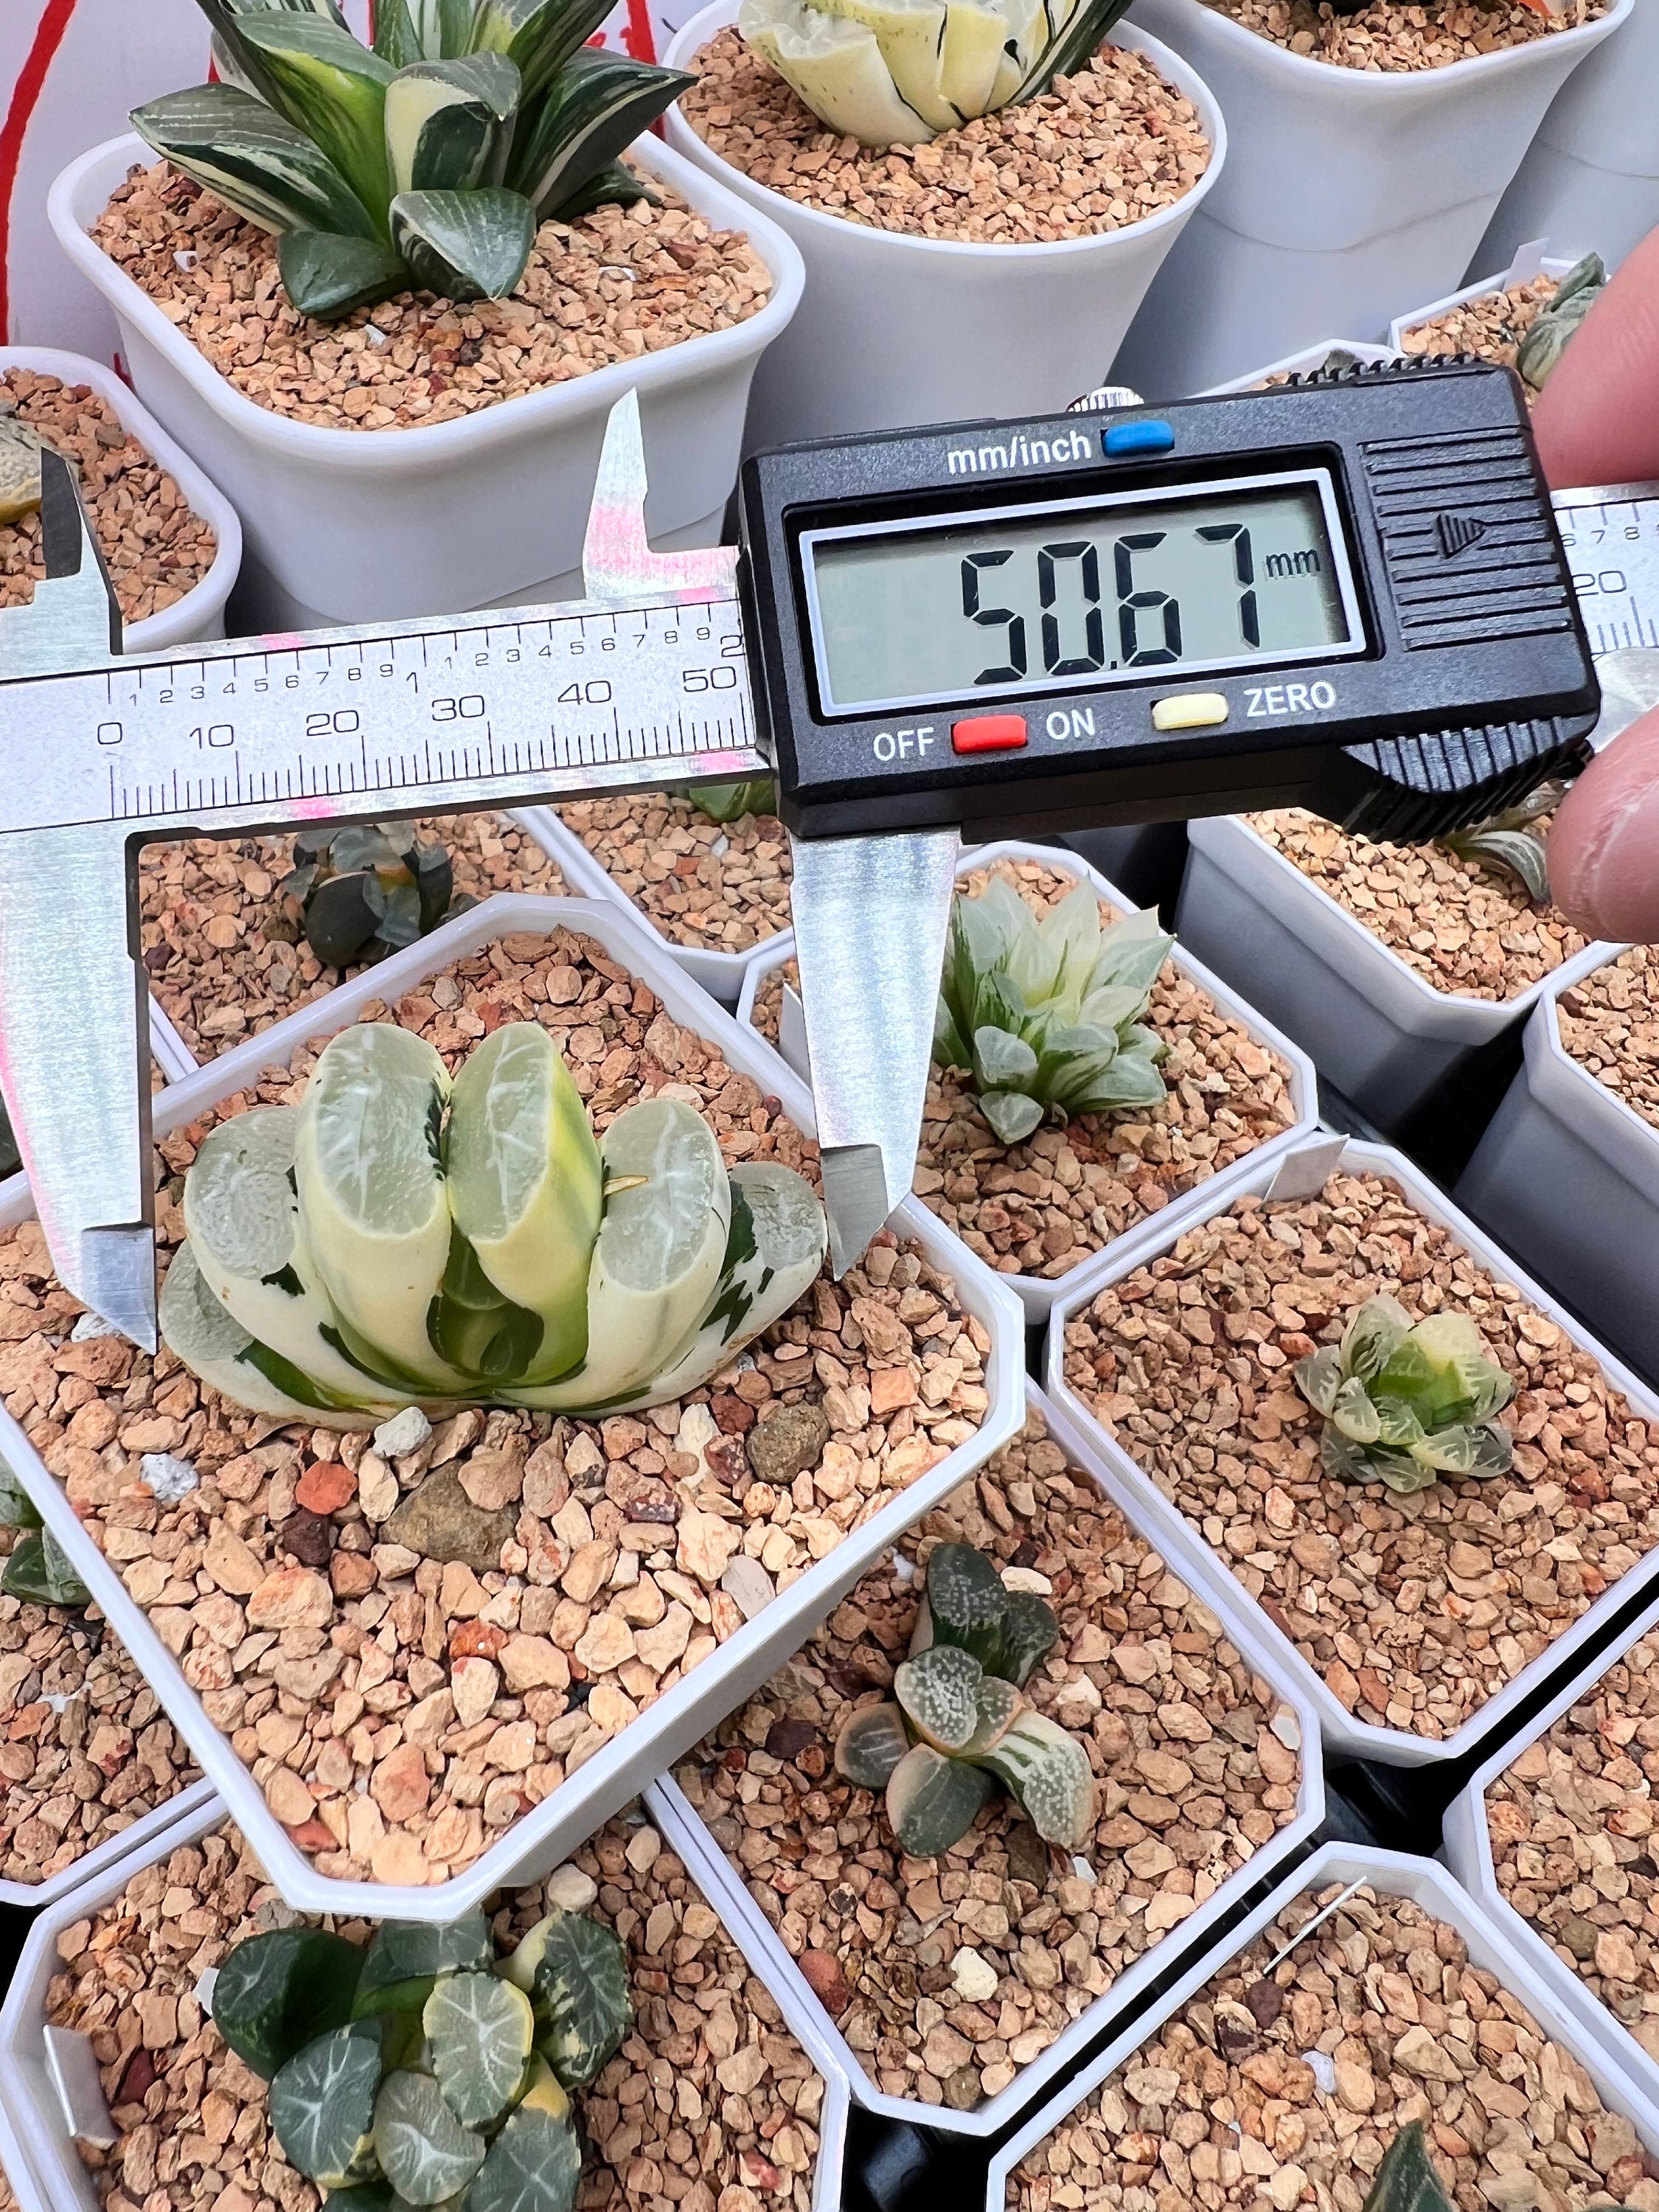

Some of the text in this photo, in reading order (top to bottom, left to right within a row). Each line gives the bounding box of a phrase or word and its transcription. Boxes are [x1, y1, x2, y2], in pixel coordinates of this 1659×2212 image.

[947, 430, 1092, 476] mm/inch
[1590, 529, 1606, 545] 7
[1624, 526, 1641, 540] 8
[961, 523, 1321, 685] 50.67 mm
[128, 627, 745, 707] 1 2 3 4 5 6 7 8 9 1 1 2 3 4 5 6 7 8 9 2
[97, 665, 737, 750] 0 10 20 30 40 50
[1243, 680, 1337, 719] ZERO
[872, 726, 936, 763] OFF
[1046, 707, 1096, 740] ON
